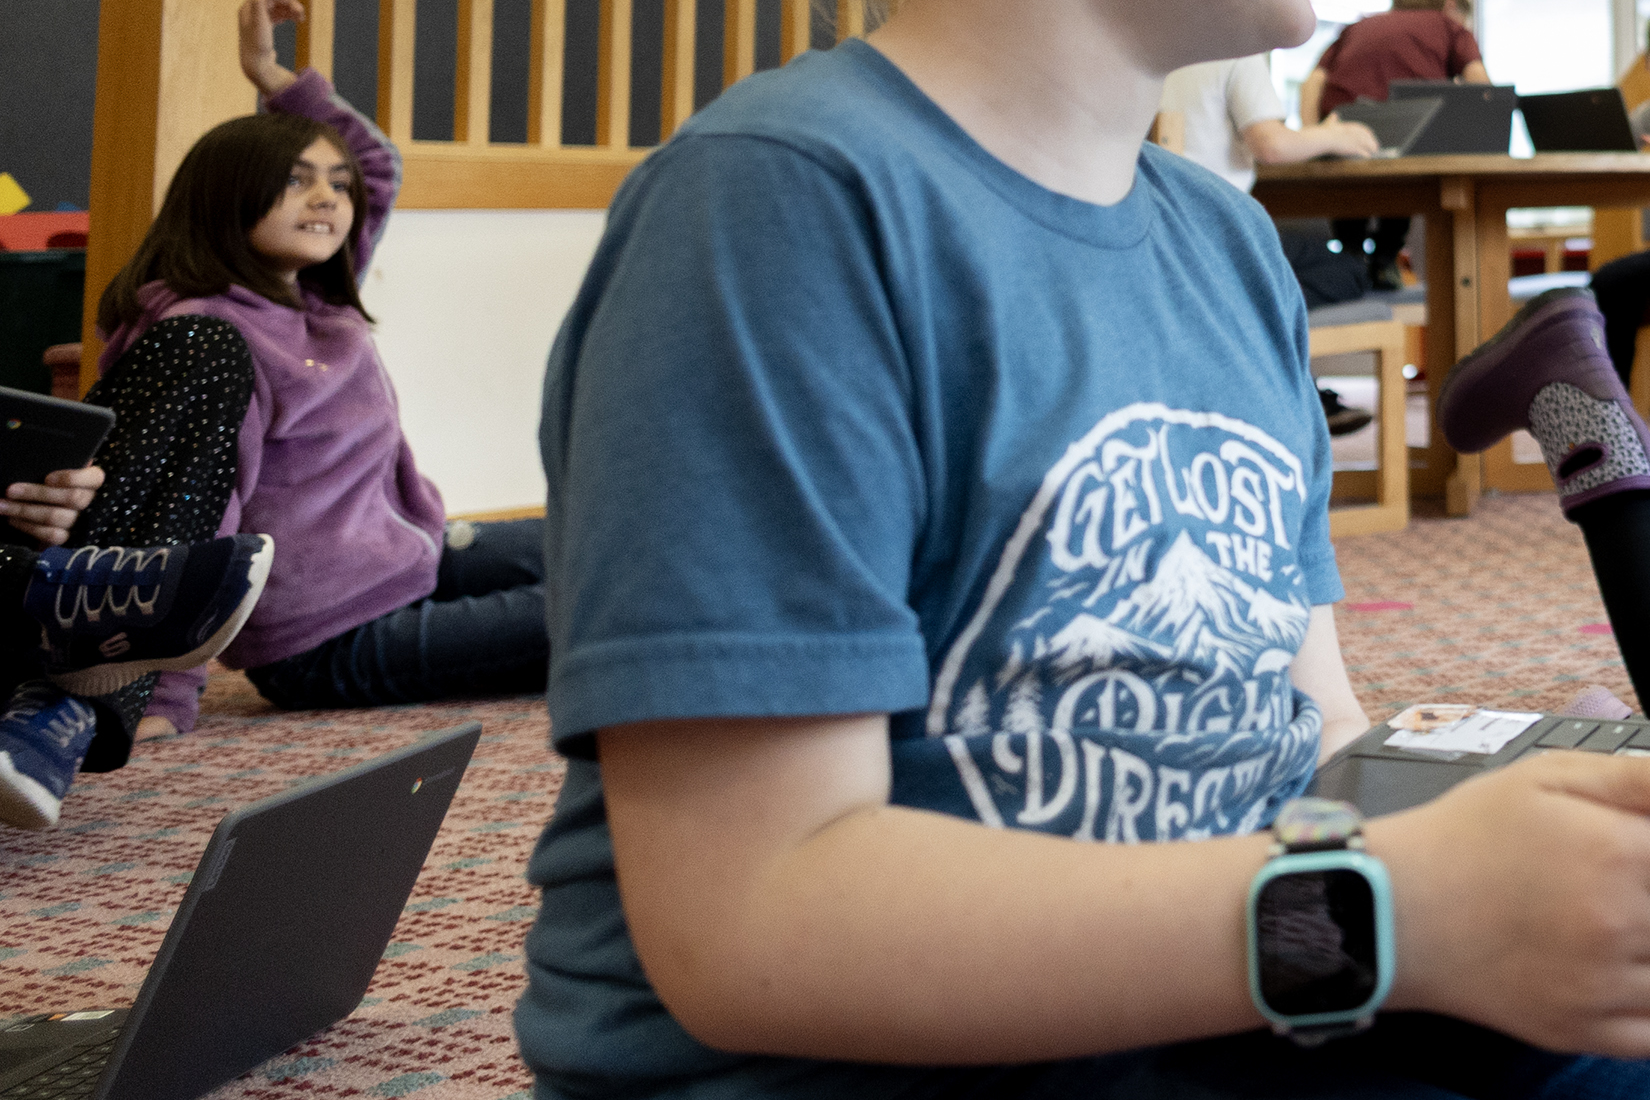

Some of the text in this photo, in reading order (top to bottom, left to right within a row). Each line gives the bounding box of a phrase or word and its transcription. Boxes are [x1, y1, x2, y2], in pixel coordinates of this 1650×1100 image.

[1046, 423, 1294, 572] GET LOST
[1081, 530, 1273, 608] IN THE
